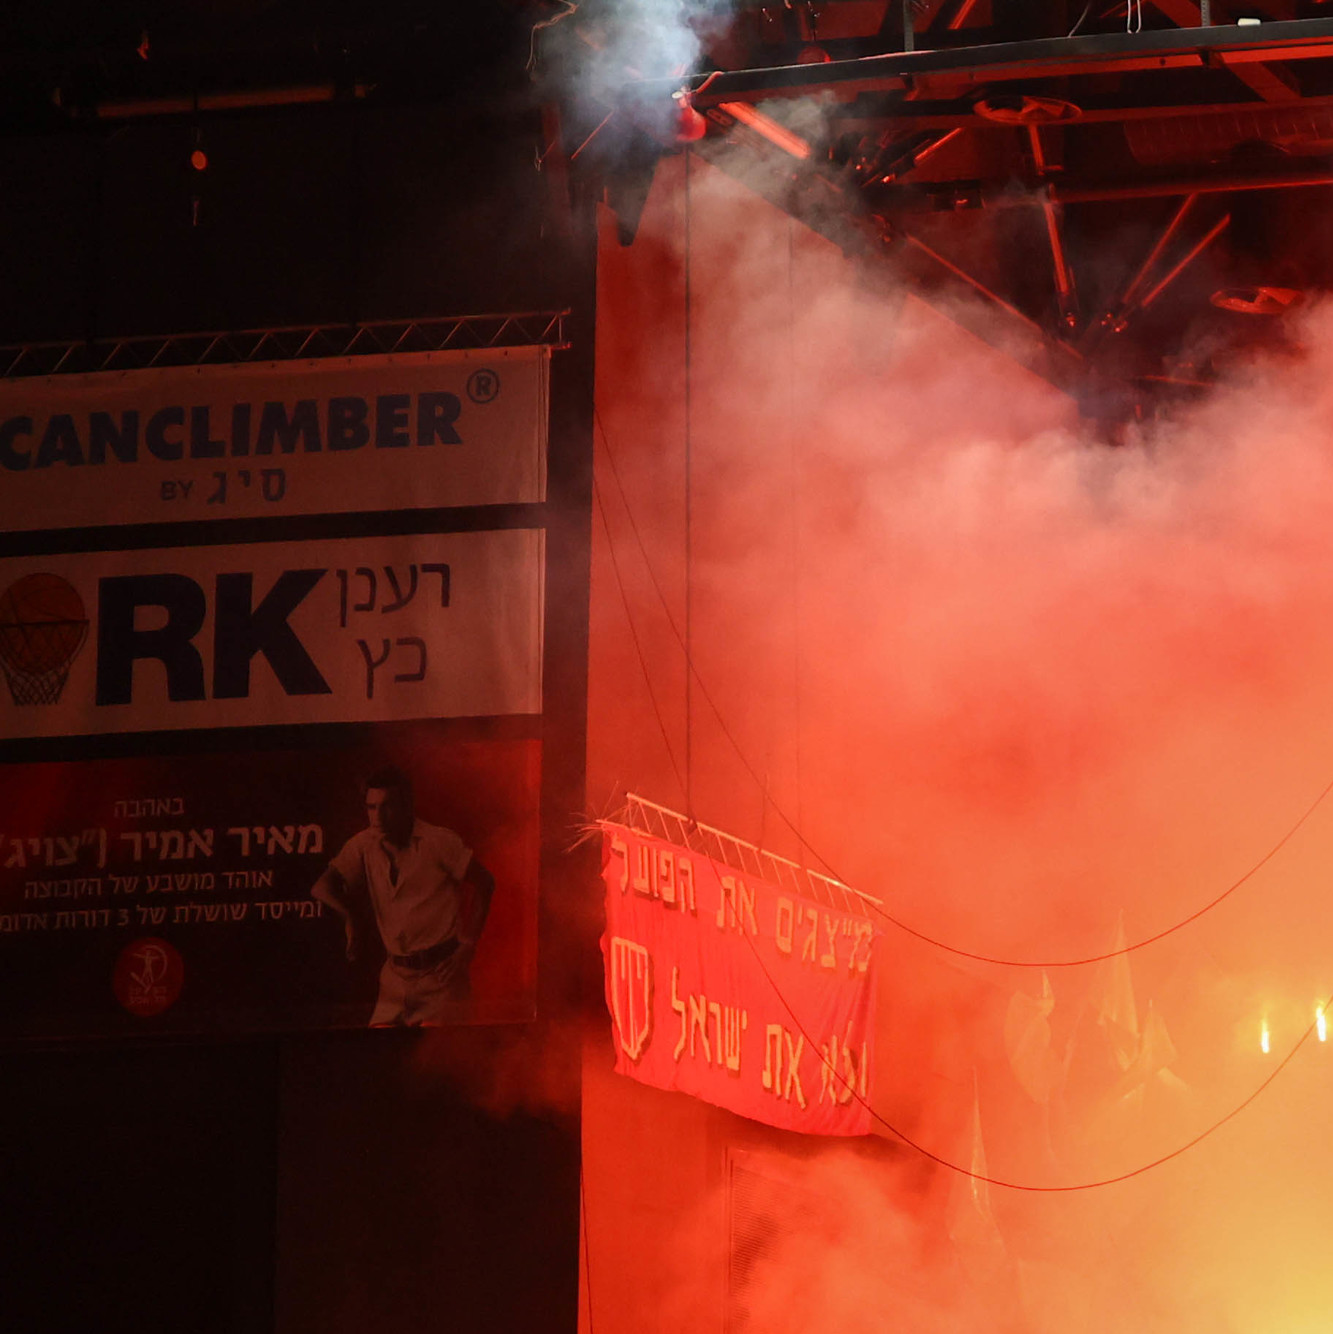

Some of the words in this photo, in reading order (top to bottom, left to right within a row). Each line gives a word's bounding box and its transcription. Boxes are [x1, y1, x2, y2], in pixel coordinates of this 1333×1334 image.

[160, 479, 193, 501] BY
[206, 467, 287, 505] סיג
[336, 562, 451, 627] רענן
[357, 635, 428, 699] כץ
[114, 798, 184, 819] באהבה
[119, 832, 214, 862] אמיר
[227, 823, 324, 857] מאיר
[24, 878, 102, 900] הקבוצה
[109, 874, 138, 896] של
[145, 872, 215, 895] מושבע
[221, 869, 273, 891] אוהד
[136, 905, 166, 926] של
[173, 901, 247, 924] שושלת
[254, 901, 323, 921] ומייסד
[716, 877, 758, 935] את
[55, 909, 111, 930] דורות
[117, 909, 129, 928] 3
[671, 966, 747, 1071] ישראל
